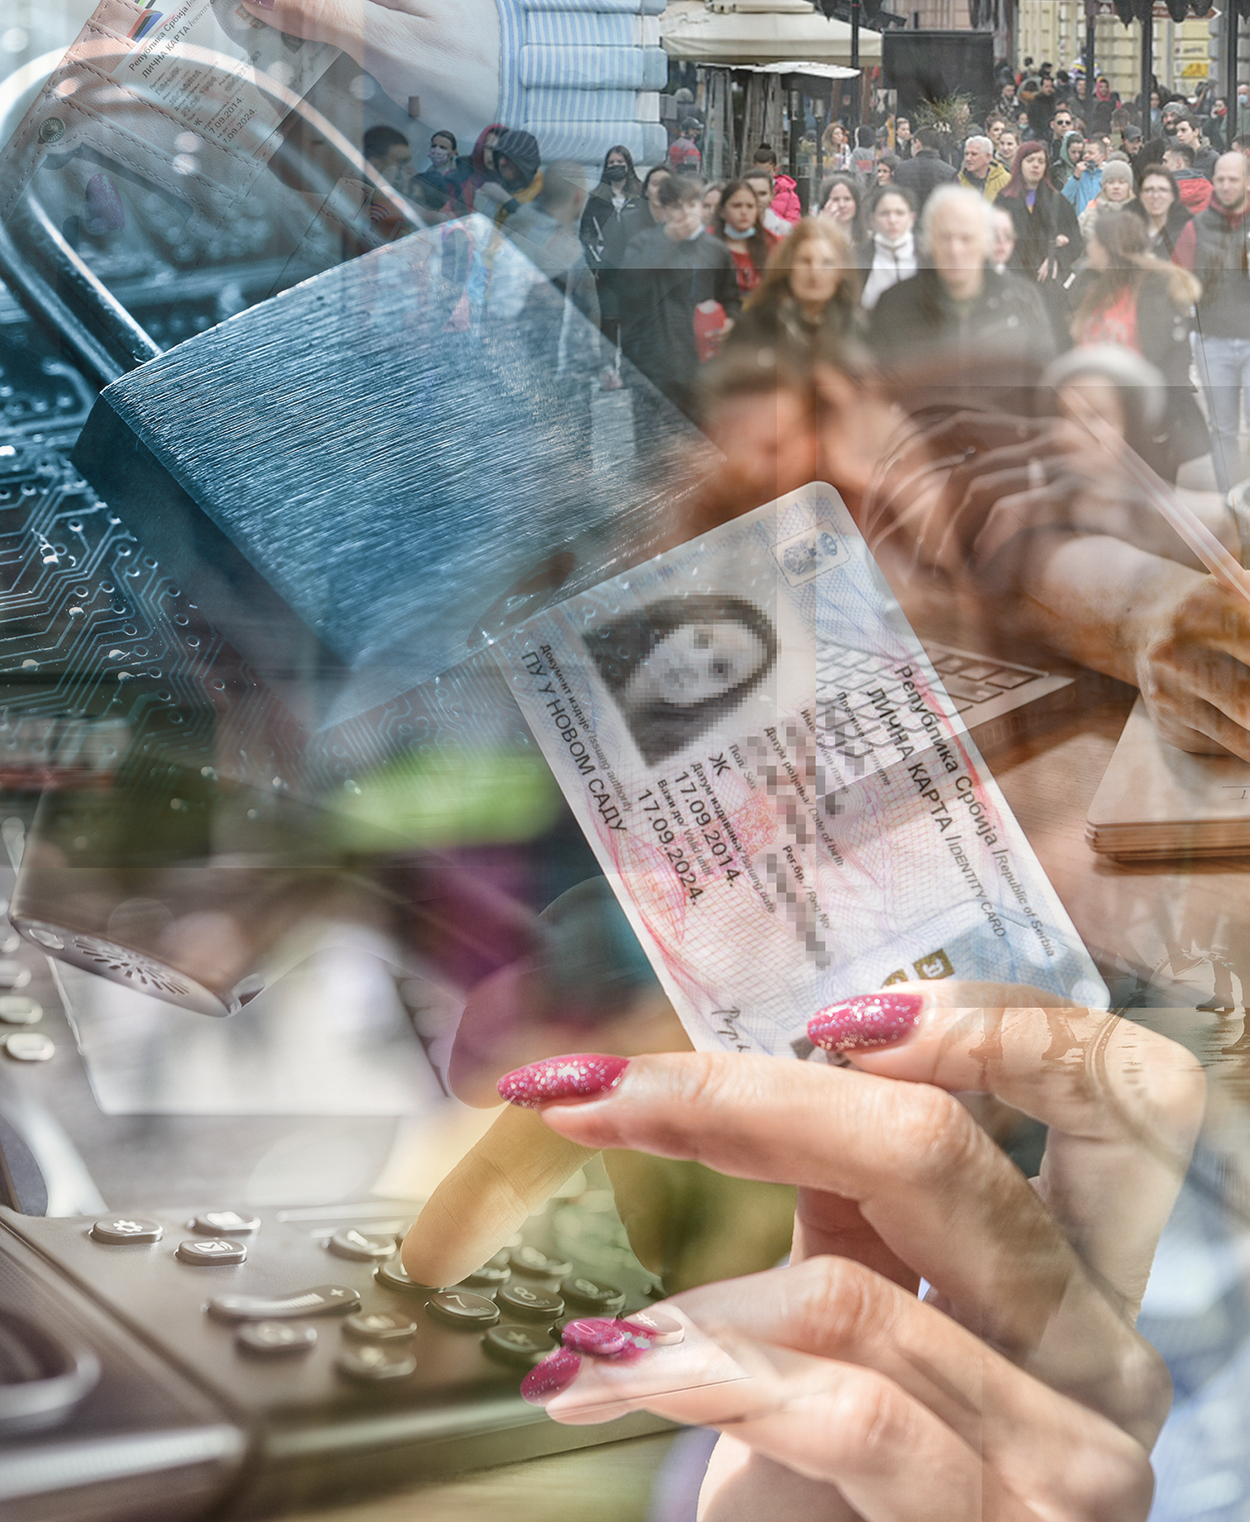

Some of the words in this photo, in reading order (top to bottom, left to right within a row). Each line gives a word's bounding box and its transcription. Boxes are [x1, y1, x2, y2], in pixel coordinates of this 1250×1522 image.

[128, 31, 166, 71] Република
[163, 6, 189, 32] Србија
[141, 50, 168, 78] ЛИЧНА
[165, 25, 190, 52] КАРТА
[521, 651, 547, 676] ПУ
[538, 682, 556, 694] У
[539, 644, 571, 695] Документ
[606, 767, 633, 812] authority
[546, 699, 596, 776] НОВОМ
[657, 779, 677, 808] Важи
[708, 752, 731, 776] Ж
[588, 778, 628, 831] САДУ
[764, 726, 785, 760] Датум
[808, 807, 826, 833] Date
[821, 832, 832, 844] of
[828, 841, 844, 867] birth
[867, 687, 915, 761] ЛИЧНА
[908, 762, 953, 832] КАРТА
[980, 901, 1006, 937] CARD
[895, 665, 959, 773] Република
[954, 775, 998, 846] Србија
[1023, 906, 1034, 918] of
[1031, 920, 1055, 957] Serbia
[638, 789, 704, 906] 17.09.2024.
[675, 771, 740, 887] 17.09.2014.
[691, 762, 713, 795] Датум
[760, 890, 776, 914] date
[446, 1294, 467, 1308] 7
[513, 1286, 537, 1300] 8
[573, 1322, 597, 1335] 0
